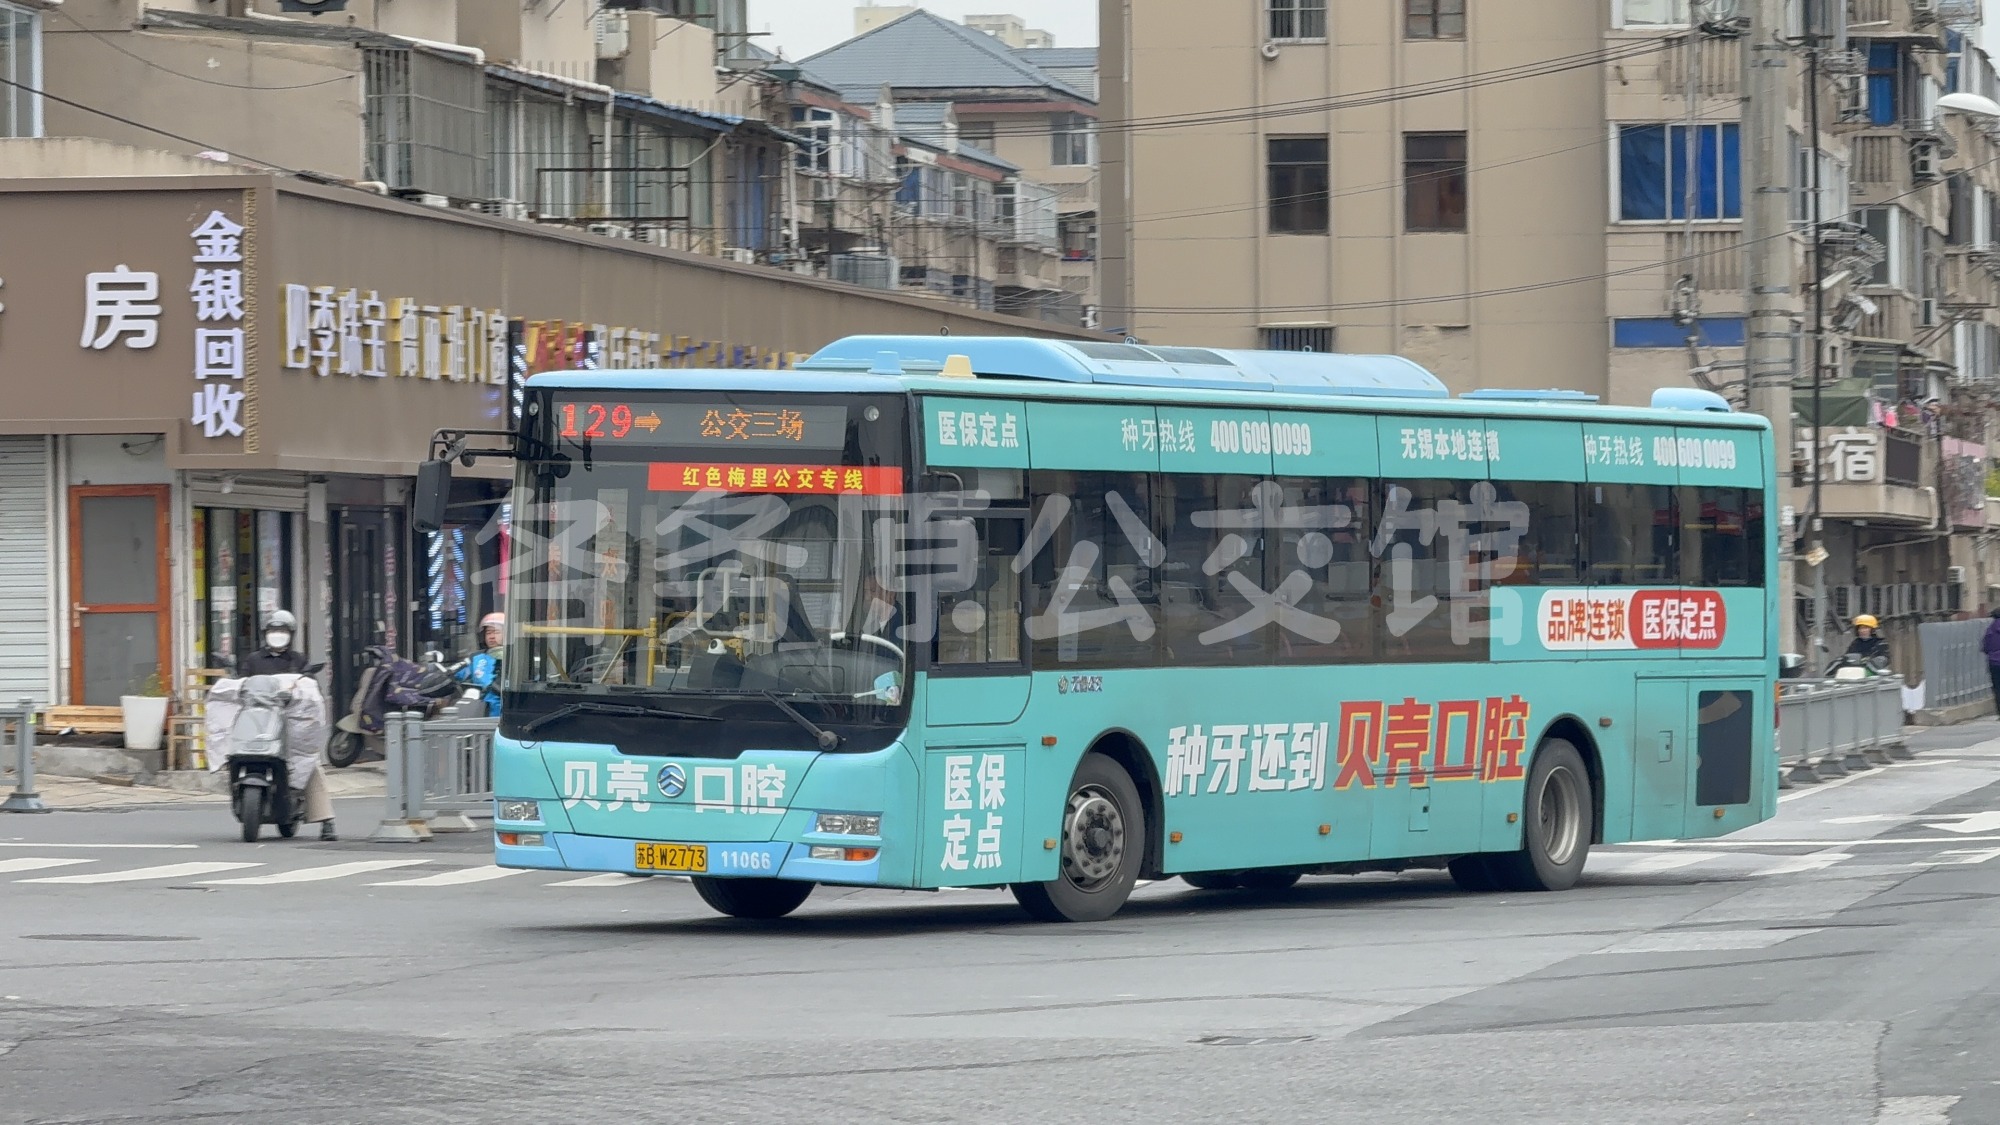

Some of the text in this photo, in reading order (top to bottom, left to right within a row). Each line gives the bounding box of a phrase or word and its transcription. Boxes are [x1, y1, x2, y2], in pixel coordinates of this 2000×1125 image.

[80, 264, 162, 350] 房
[190, 210, 244, 438] 金银回收
[561, 403, 633, 438] 129
[700, 409, 805, 441] 公交三场
[938, 411, 1019, 448] 医保定点
[1121, 417, 1312, 456] 种牙热线 400 609 0099
[1401, 428, 1501, 463] 无锡本地连锁
[1585, 434, 1644, 467] 种牙热线
[1653, 436, 1677, 467] 400
[1704, 440, 1736, 470] 0099
[682, 466, 865, 491] 红色梅里公交专线
[1547, 598, 1627, 642] 品牌连锁
[1642, 598, 1717, 641] 医保定点
[1165, 694, 1531, 797] 种牙还到 贝壳口腔
[564, 760, 787, 815] 贝壳 口腔
[944, 753, 1006, 811] 医保
[721, 850, 771, 870] 11066
[940, 811, 1003, 871] 定点
